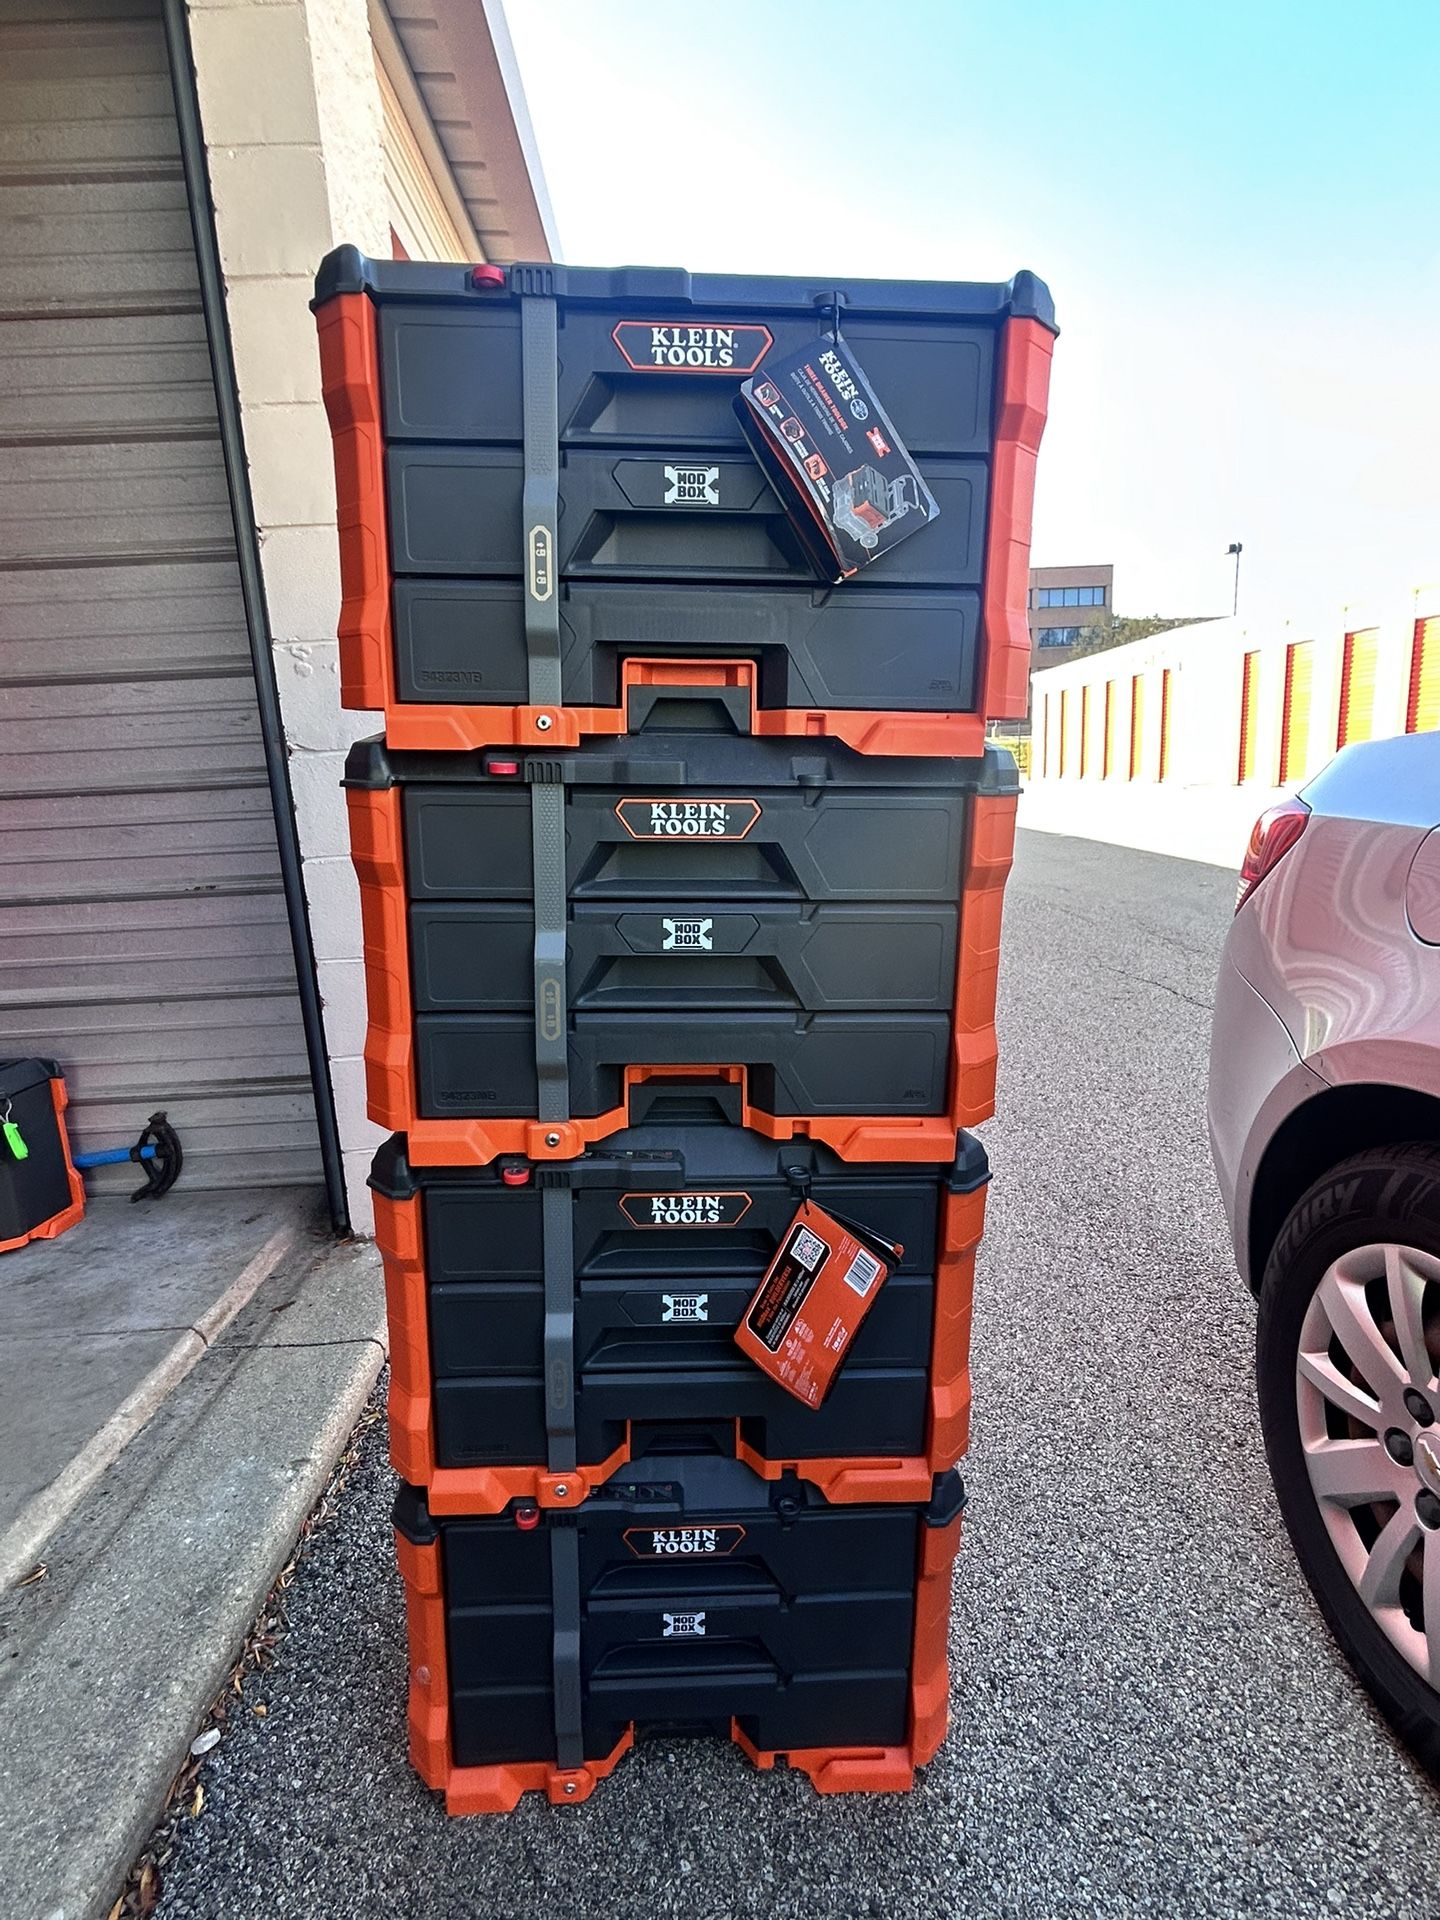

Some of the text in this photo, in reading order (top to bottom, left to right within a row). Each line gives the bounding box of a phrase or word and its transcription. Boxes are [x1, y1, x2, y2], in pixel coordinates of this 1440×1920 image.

[651, 327, 734, 348] KLEIN
[651, 346, 733, 367] TOOLS
[818, 354, 852, 401] TOOLS
[826, 350, 859, 398] KLEIN
[677, 472, 706, 485] MOD
[677, 486, 706, 498] BOX
[650, 803, 726, 819] KLEIN
[650, 819, 725, 835] TOOLS
[674, 923, 701, 934] MOD
[674, 934, 701, 945] BOX
[651, 1196, 721, 1210] KLEIN
[651, 1210, 720, 1224] TOOLS
[673, 1298, 697, 1308] MOD
[673, 1308, 697, 1317] BOX
[652, 1529, 716, 1543] KLEIN
[652, 1541, 716, 1554] TOOLS
[673, 1616, 696, 1624] MOD
[673, 1624, 696, 1632] BOX
